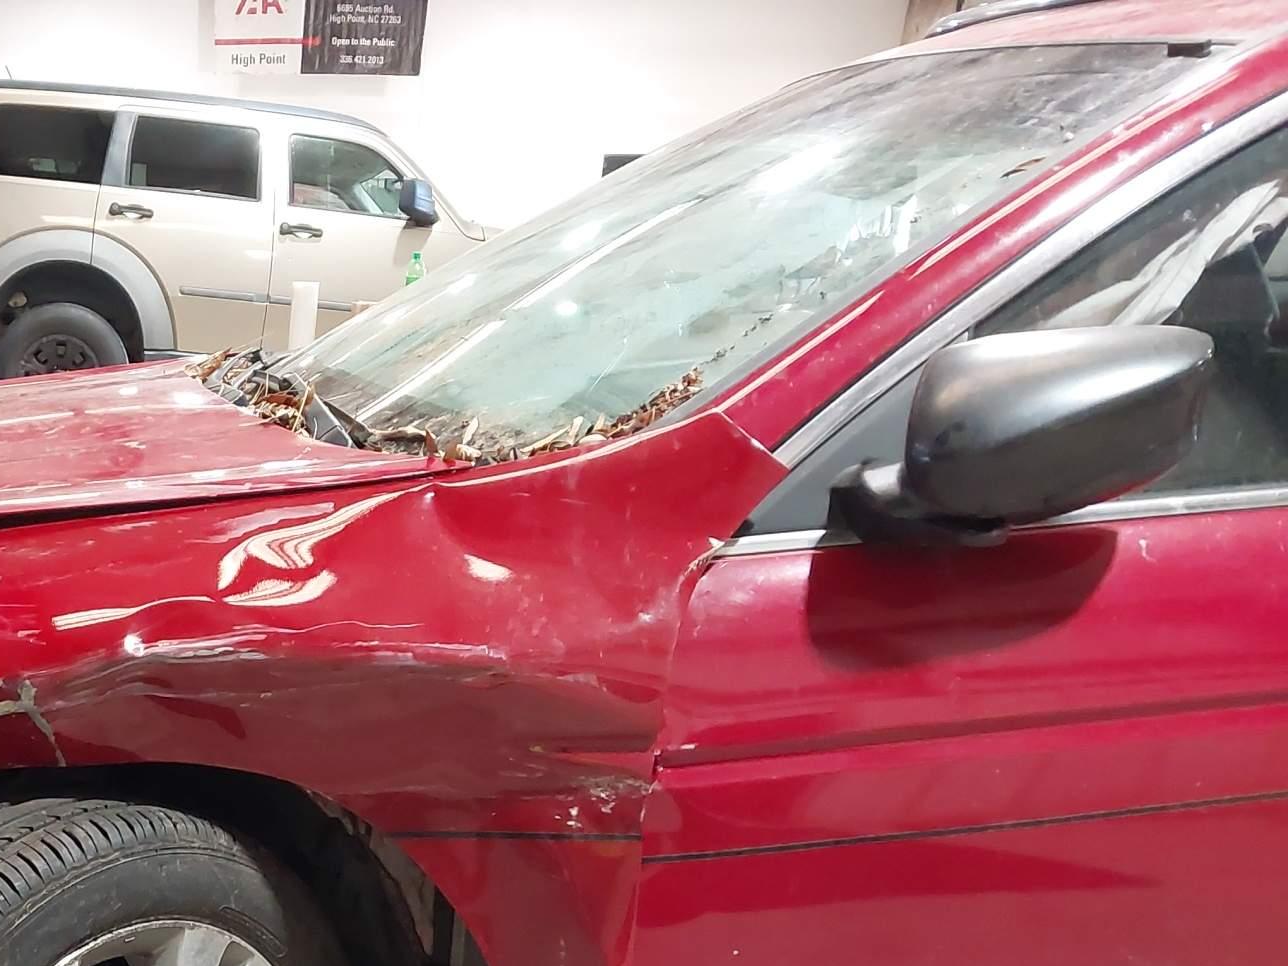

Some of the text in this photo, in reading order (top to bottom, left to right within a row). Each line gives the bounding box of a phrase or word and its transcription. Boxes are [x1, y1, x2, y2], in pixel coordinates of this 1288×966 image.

[355, 4, 382, 13] Auction
[329, 14, 346, 24] High
[368, 15, 379, 24] NC
[331, 37, 396, 47] Open to the Public
[231, 52, 286, 67] High Point
